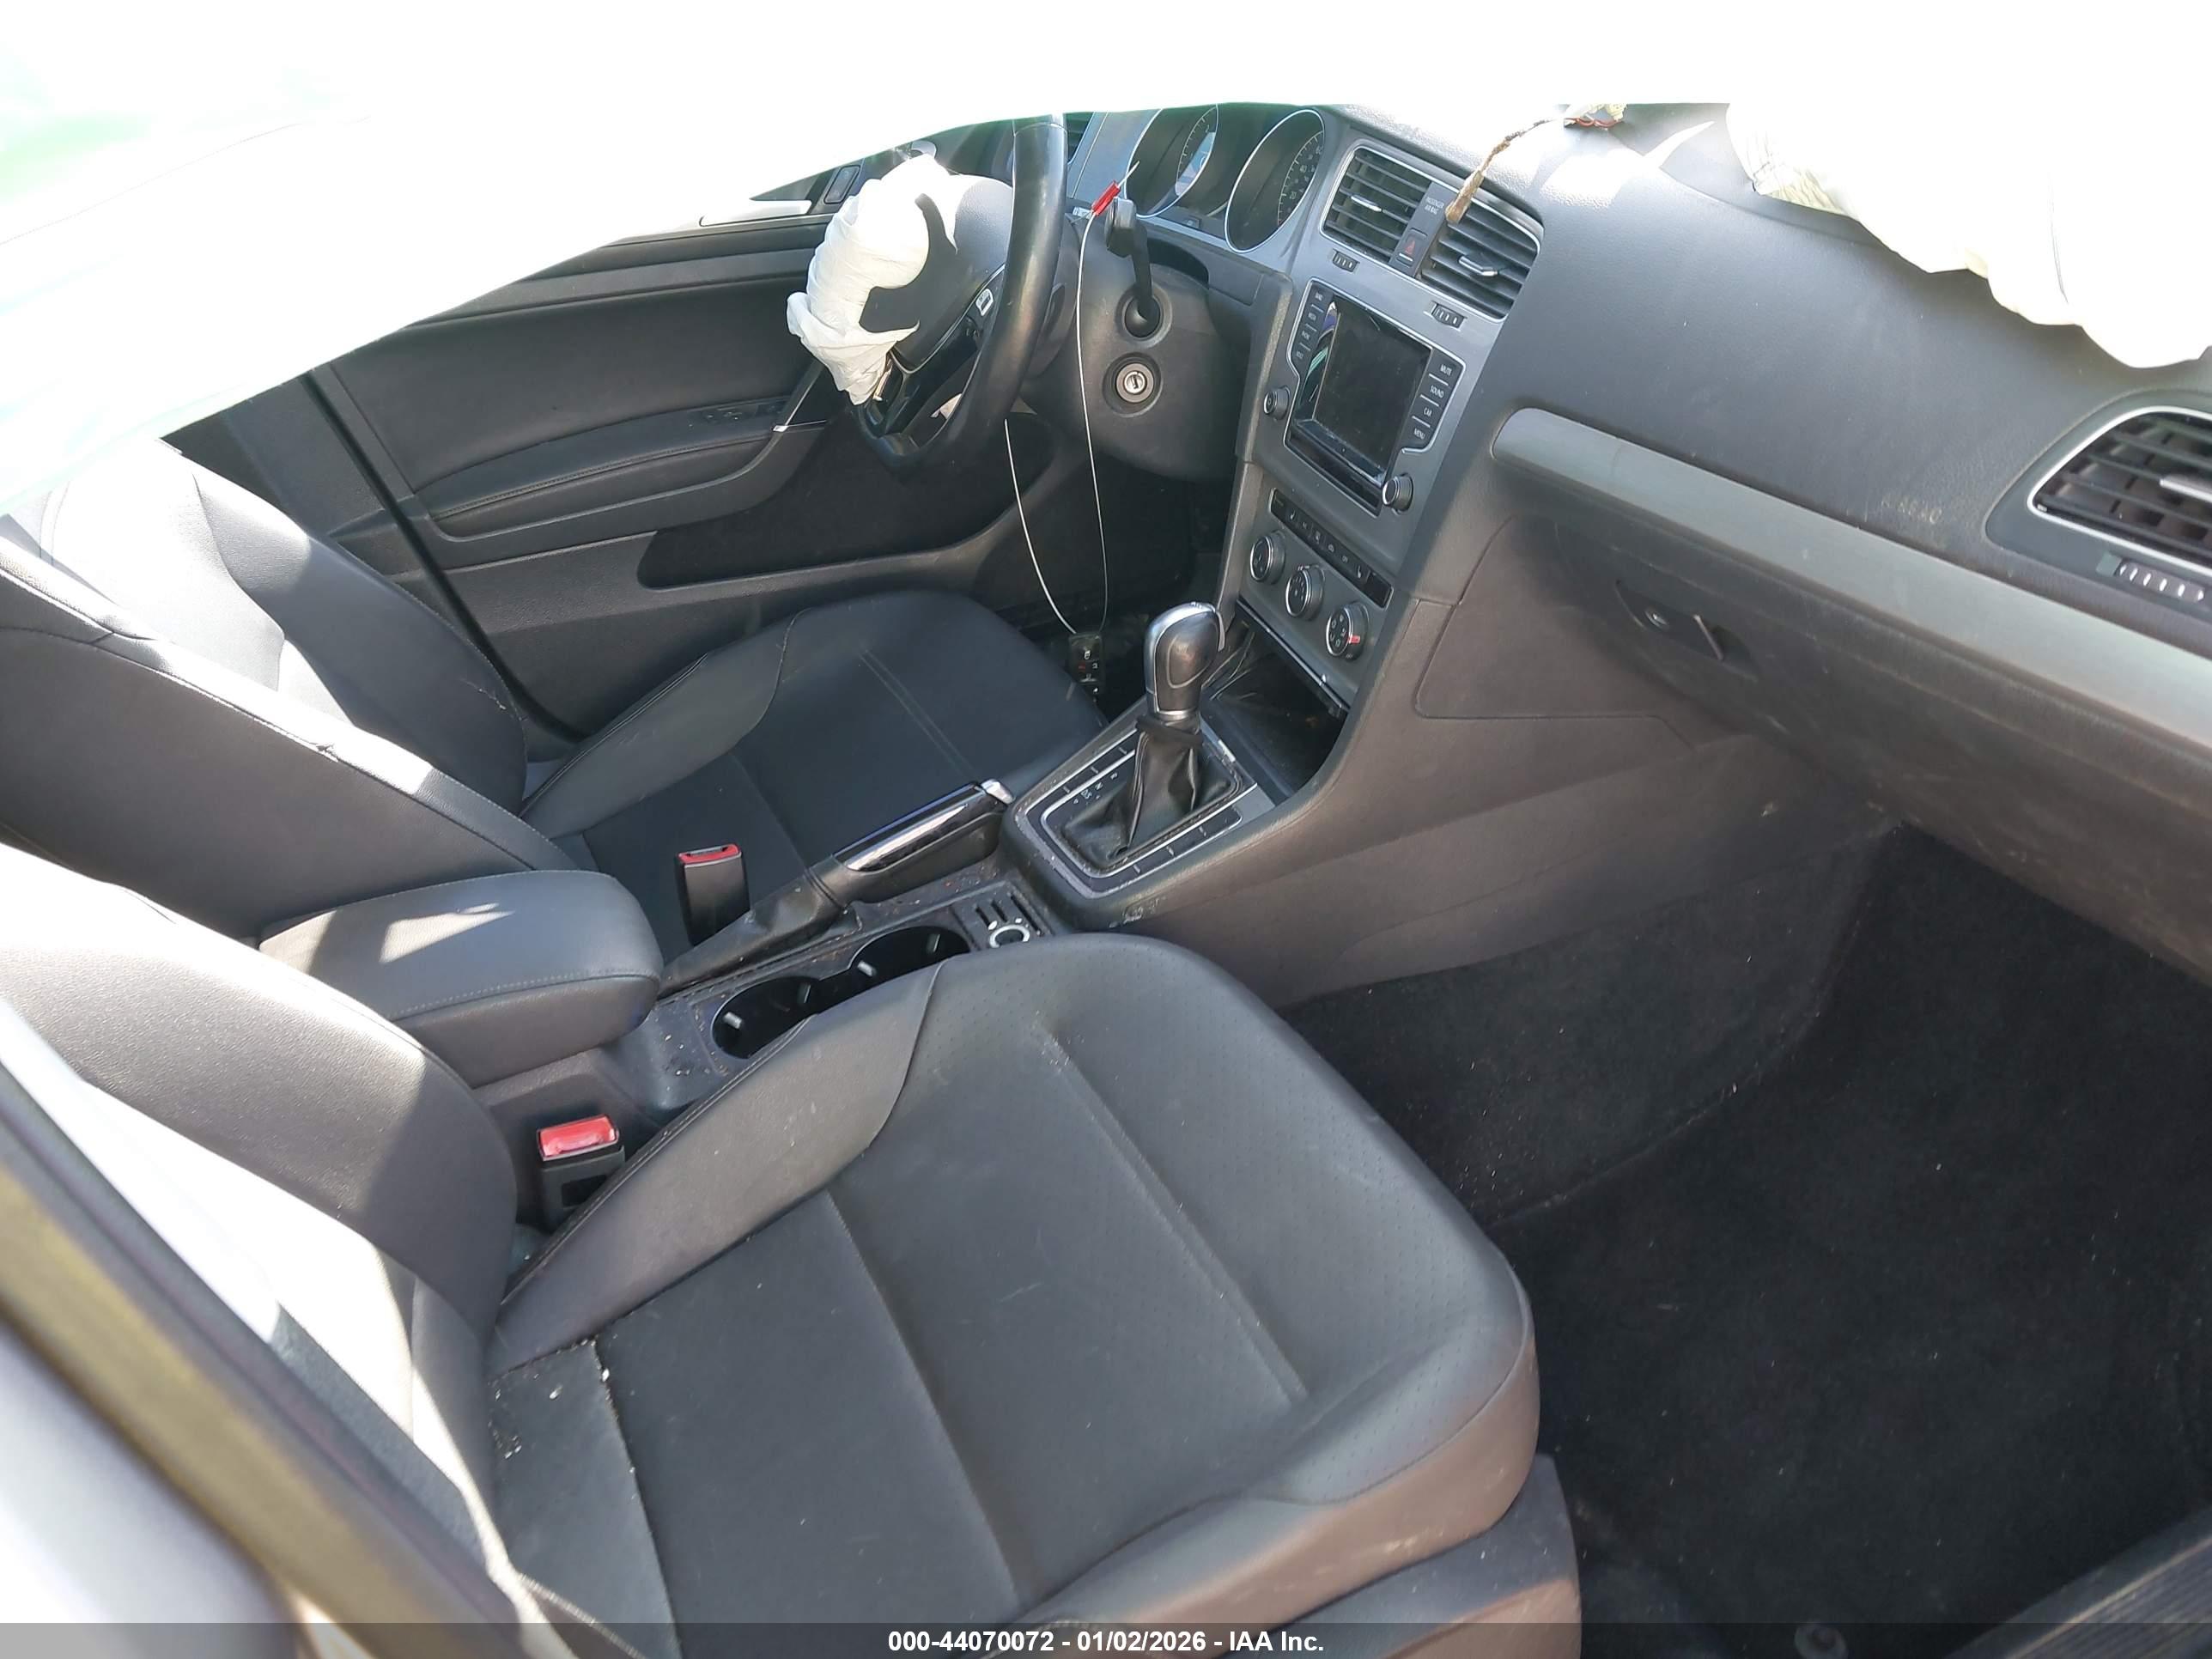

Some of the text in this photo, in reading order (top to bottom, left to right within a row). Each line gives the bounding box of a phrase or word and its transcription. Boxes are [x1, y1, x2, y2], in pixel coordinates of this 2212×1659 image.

[1440, 364, 1452, 376] MUTE
[1430, 385, 1444, 398] SOUND
[1423, 407, 1432, 417] CAR
[1413, 428, 1425, 440] MENU
